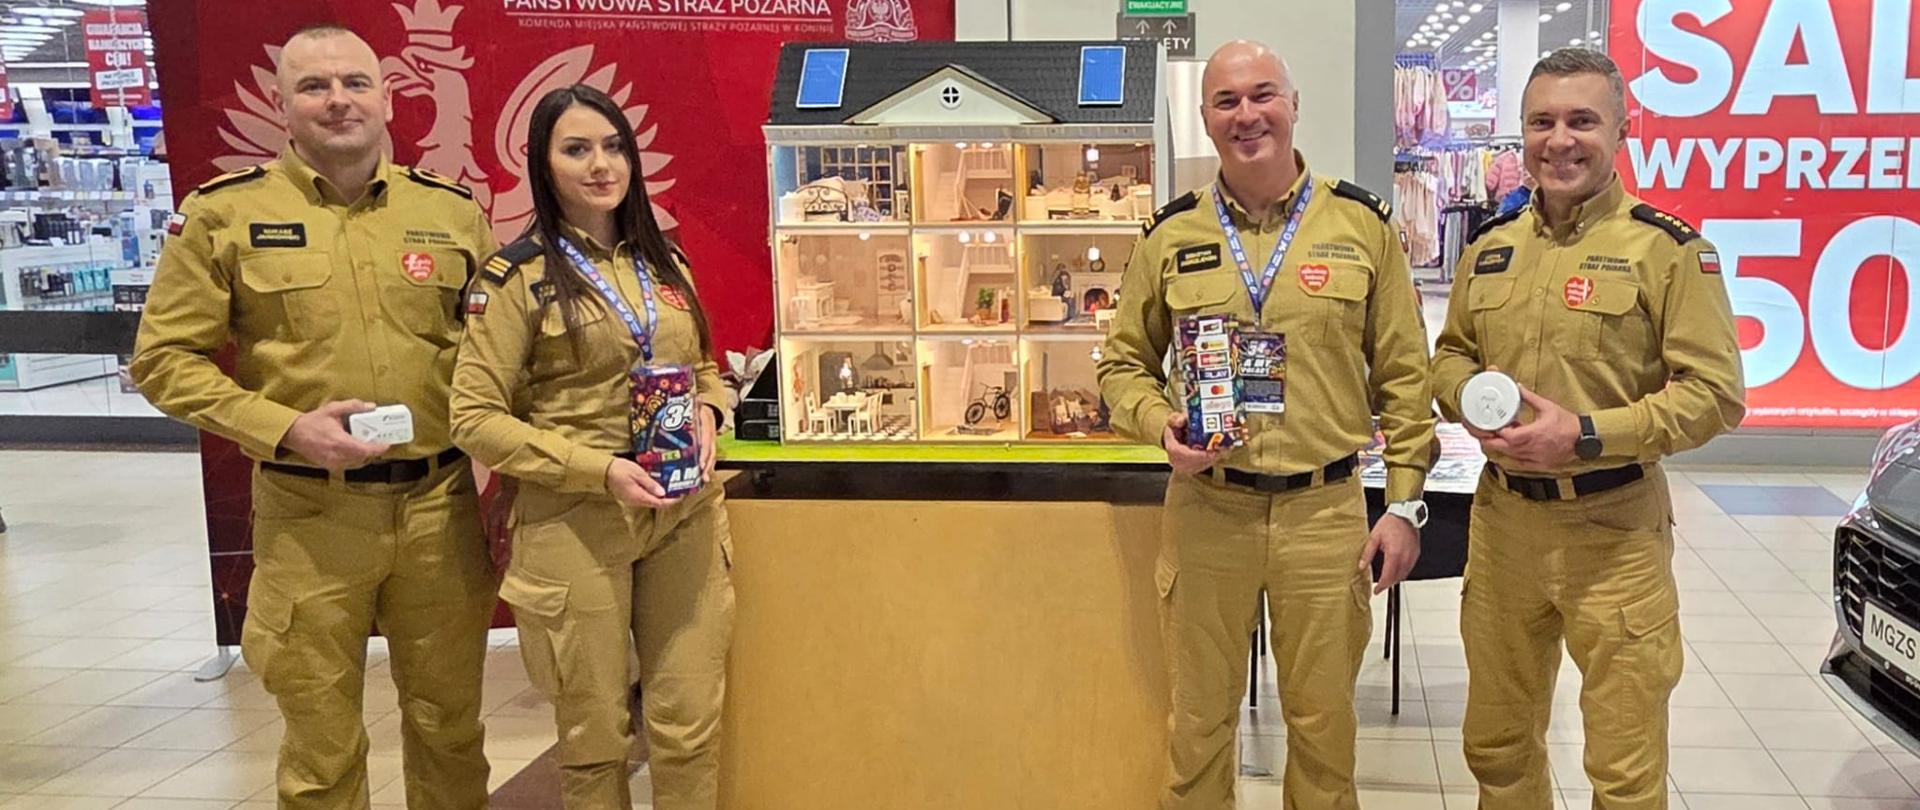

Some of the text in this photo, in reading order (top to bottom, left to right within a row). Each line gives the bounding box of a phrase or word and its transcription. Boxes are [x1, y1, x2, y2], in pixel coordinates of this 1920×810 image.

[504, 0, 832, 15] PAŃSTWOWA STRAŻ POŻARNA
[518, 19, 834, 34] KOMENDA MIEJSKA PAŃSTWOWEJ STRAŻY POŻARNEJ W KONINIE
[1628, 0, 1920, 117] SAL
[1701, 215, 1920, 389] 50
[1871, 613, 1917, 660] MGZS
